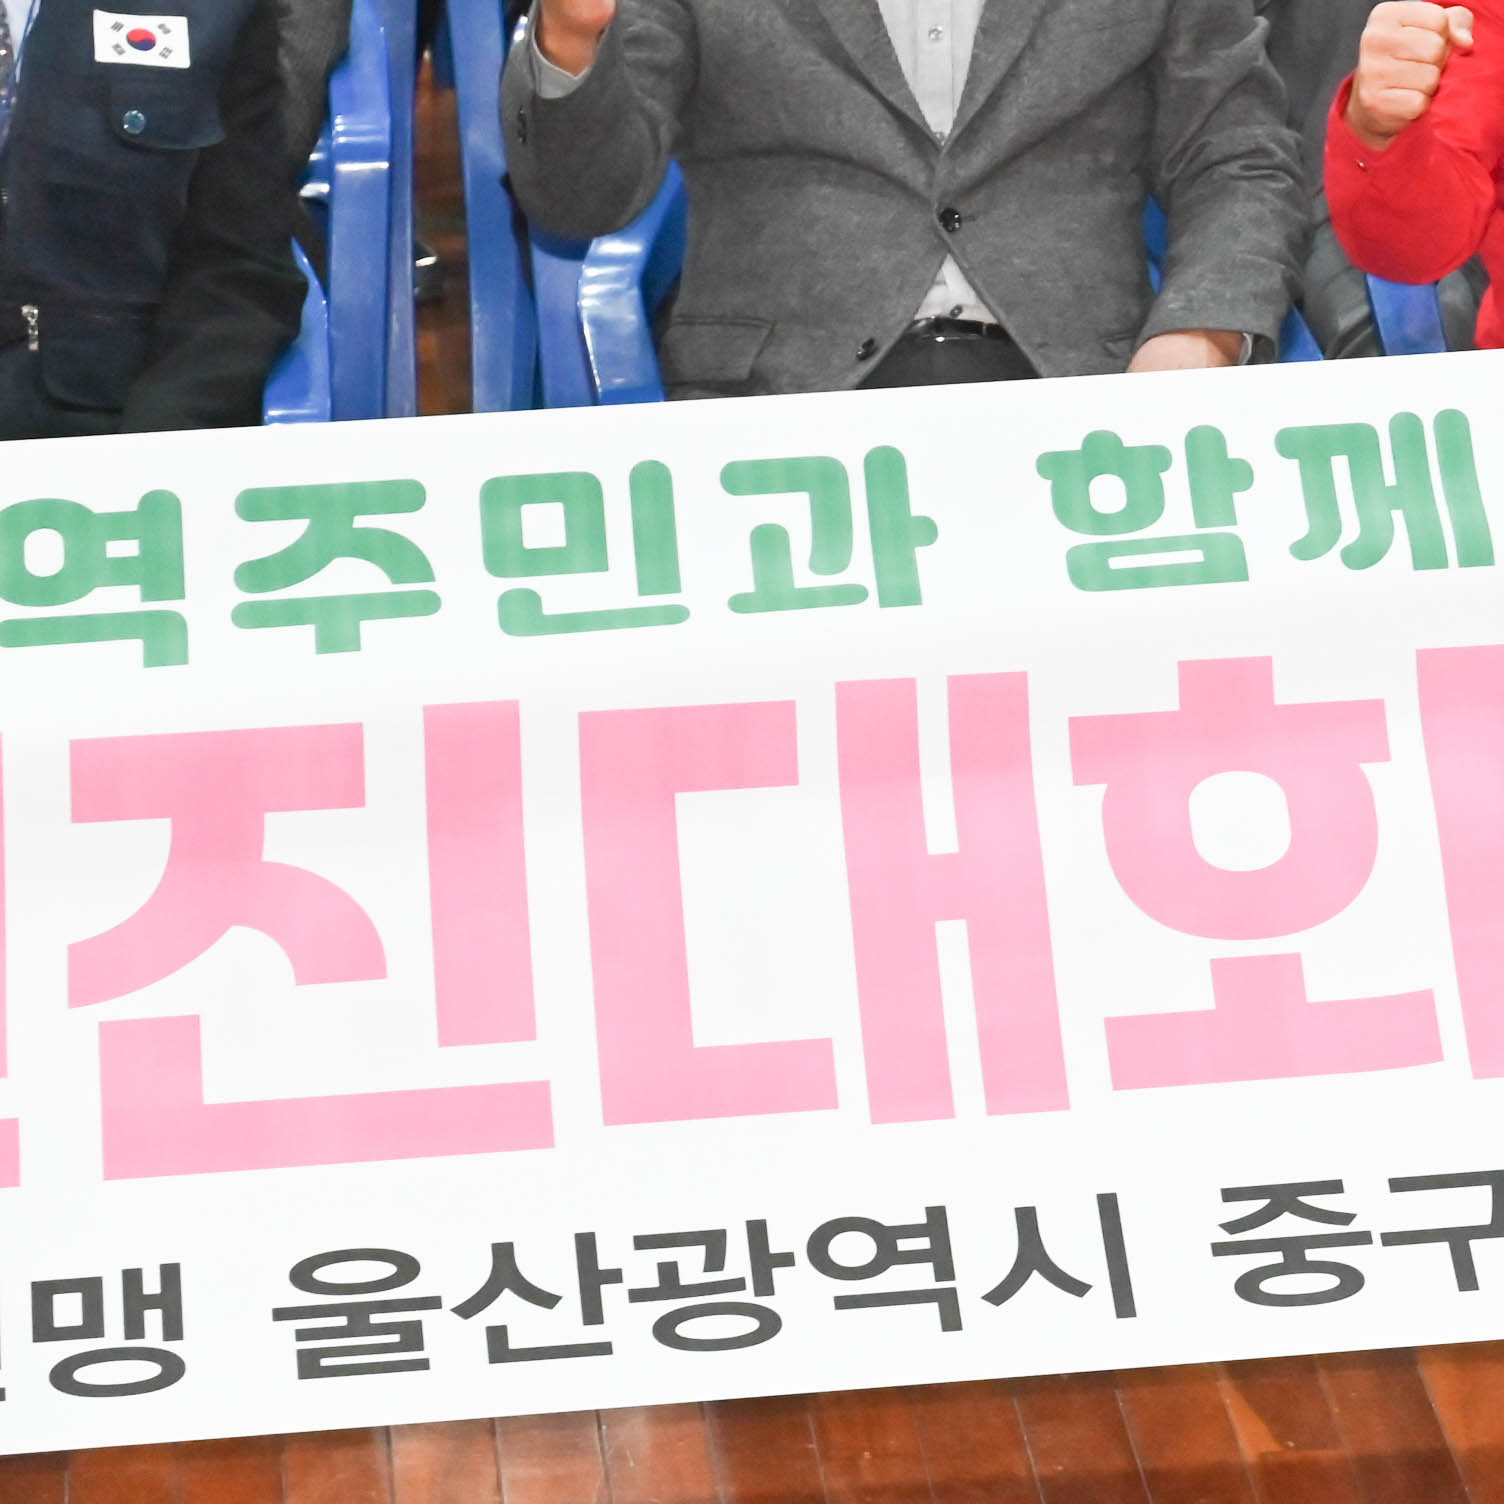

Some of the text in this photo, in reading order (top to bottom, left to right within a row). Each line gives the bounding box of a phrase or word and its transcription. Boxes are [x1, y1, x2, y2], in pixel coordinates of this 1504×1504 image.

[0, 445, 939, 668] 역주민과
[0, 1262, 187, 1399] 맹
[272, 1192, 1138, 1380] 울산광역시
